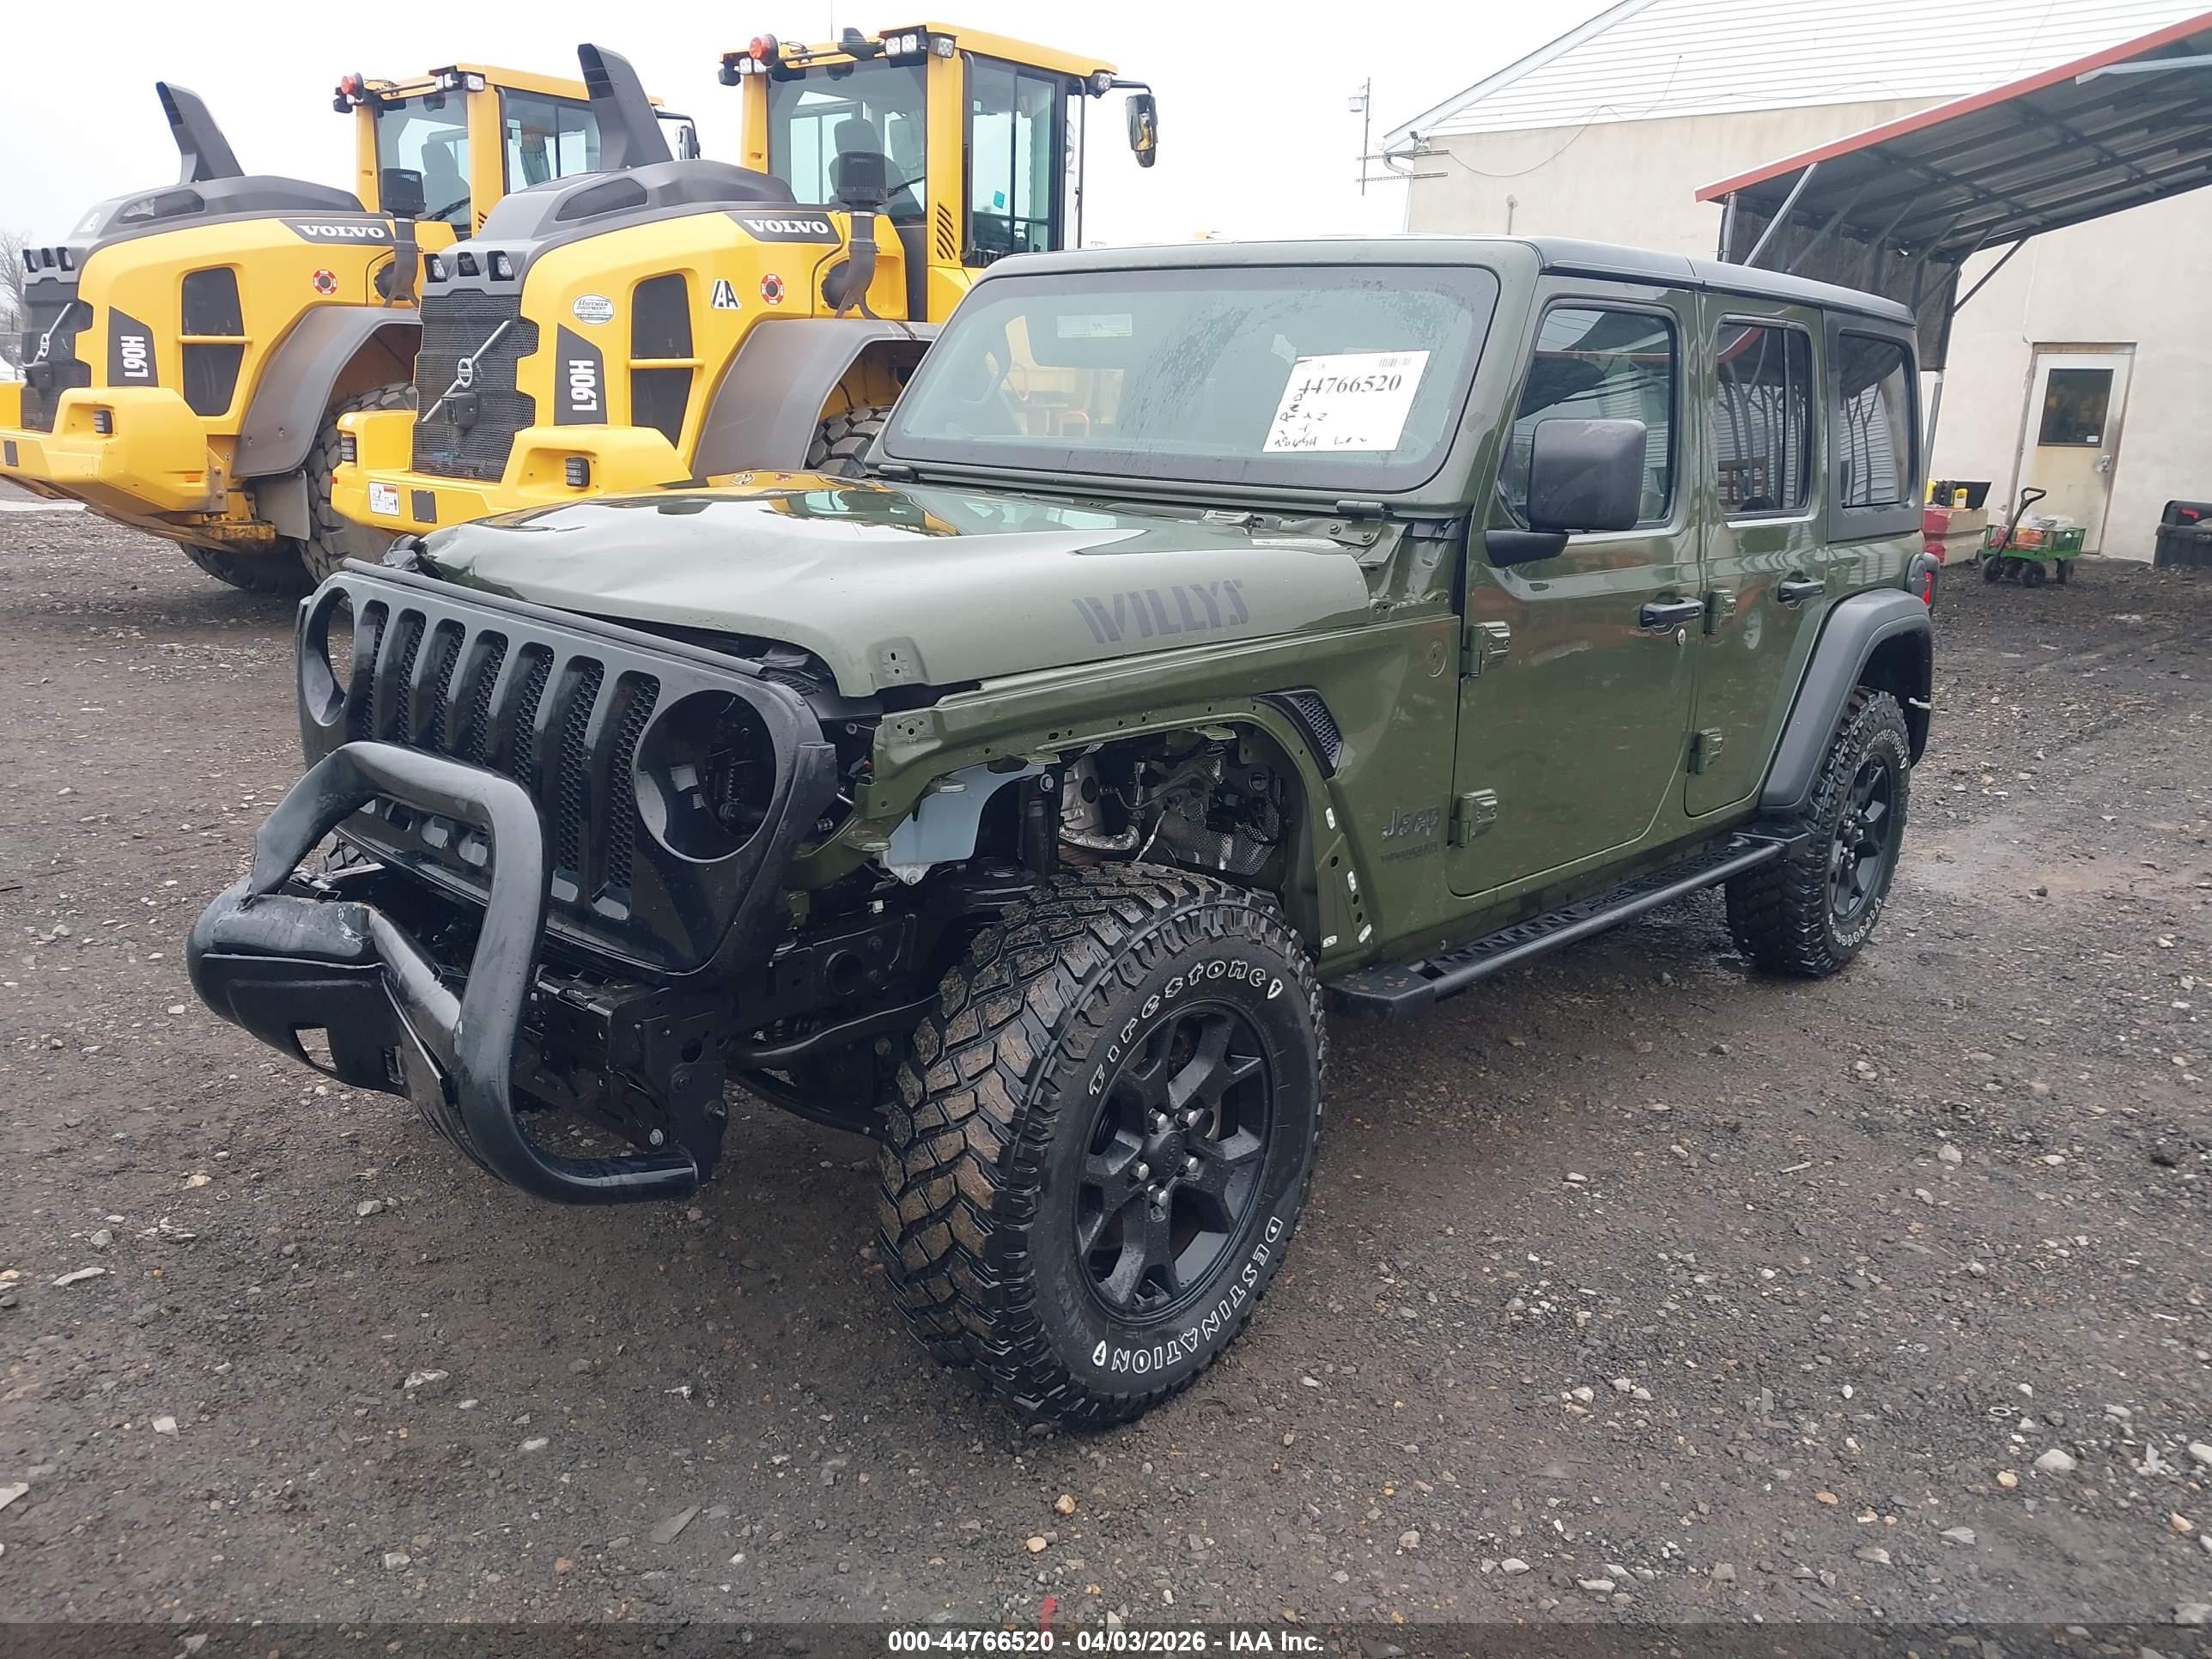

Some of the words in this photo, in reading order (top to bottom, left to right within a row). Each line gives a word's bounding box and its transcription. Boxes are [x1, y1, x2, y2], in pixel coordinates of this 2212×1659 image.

[297, 225, 386, 239] VOLVO
[743, 219, 829, 234] VOLVO
[120, 336, 149, 378] L90H
[568, 360, 598, 411] L90H
[1298, 374, 1402, 394] 44766520
[1072, 579, 1249, 644] WILLYS
[1381, 806, 1438, 841] Jeep
[1089, 959, 1267, 1097] Firestone
[1110, 1218, 1284, 1375] DESTINATION
